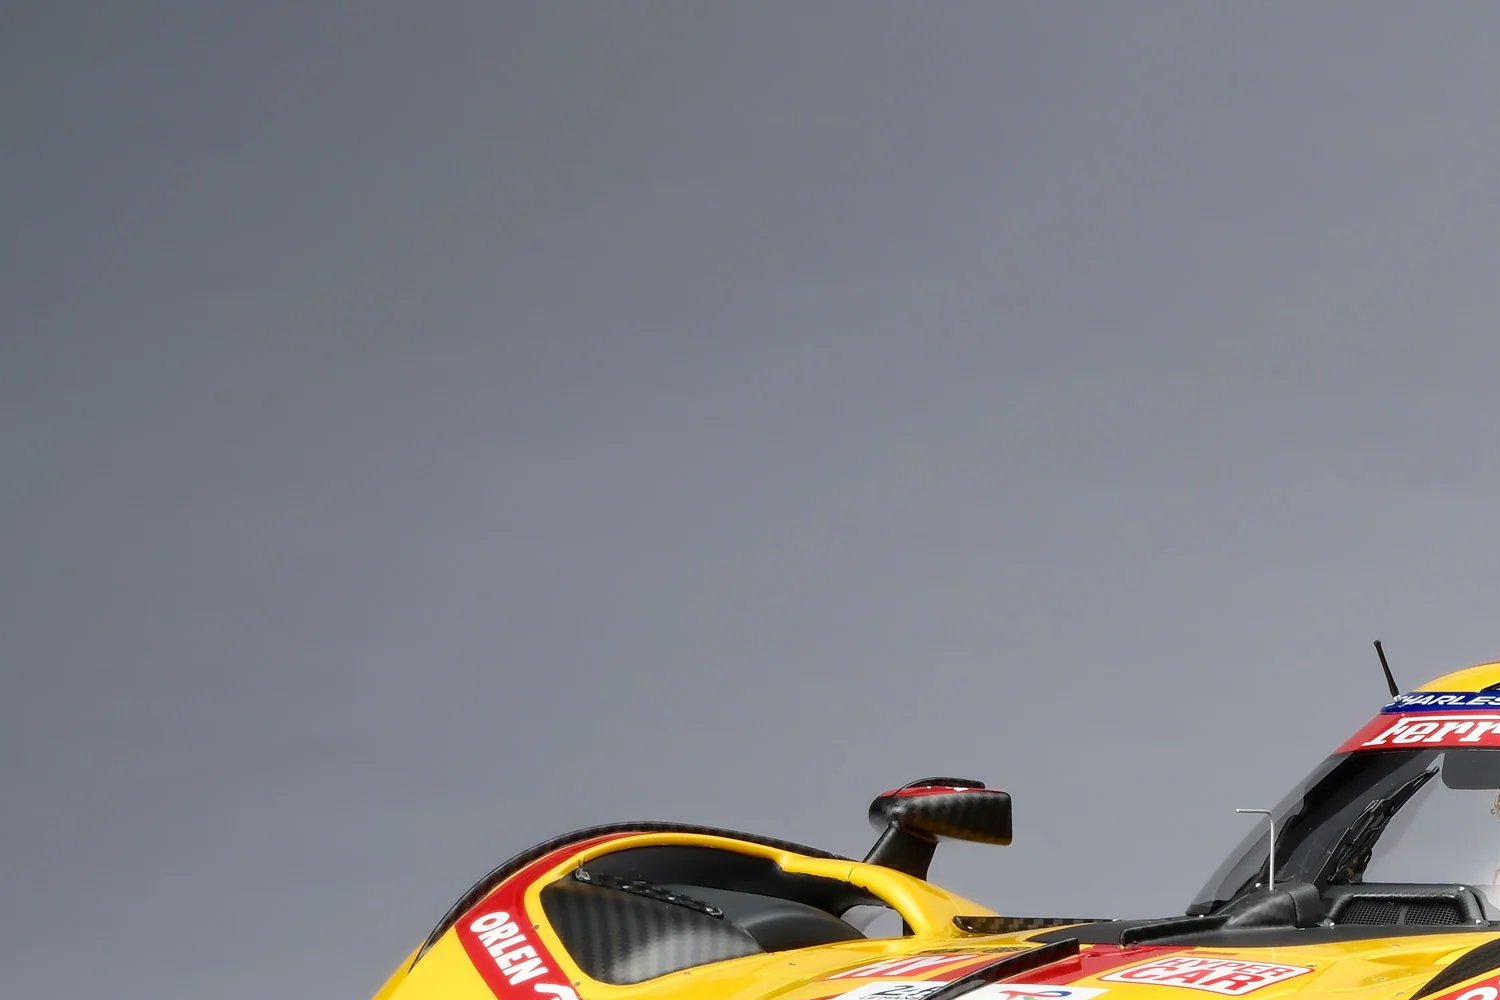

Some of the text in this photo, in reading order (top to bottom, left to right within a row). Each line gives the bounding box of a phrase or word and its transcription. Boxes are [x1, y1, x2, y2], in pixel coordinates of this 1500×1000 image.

[470, 911, 549, 986] ORLEN
[1119, 966, 1267, 991] CAR
[1156, 958, 1295, 978] HYPER
